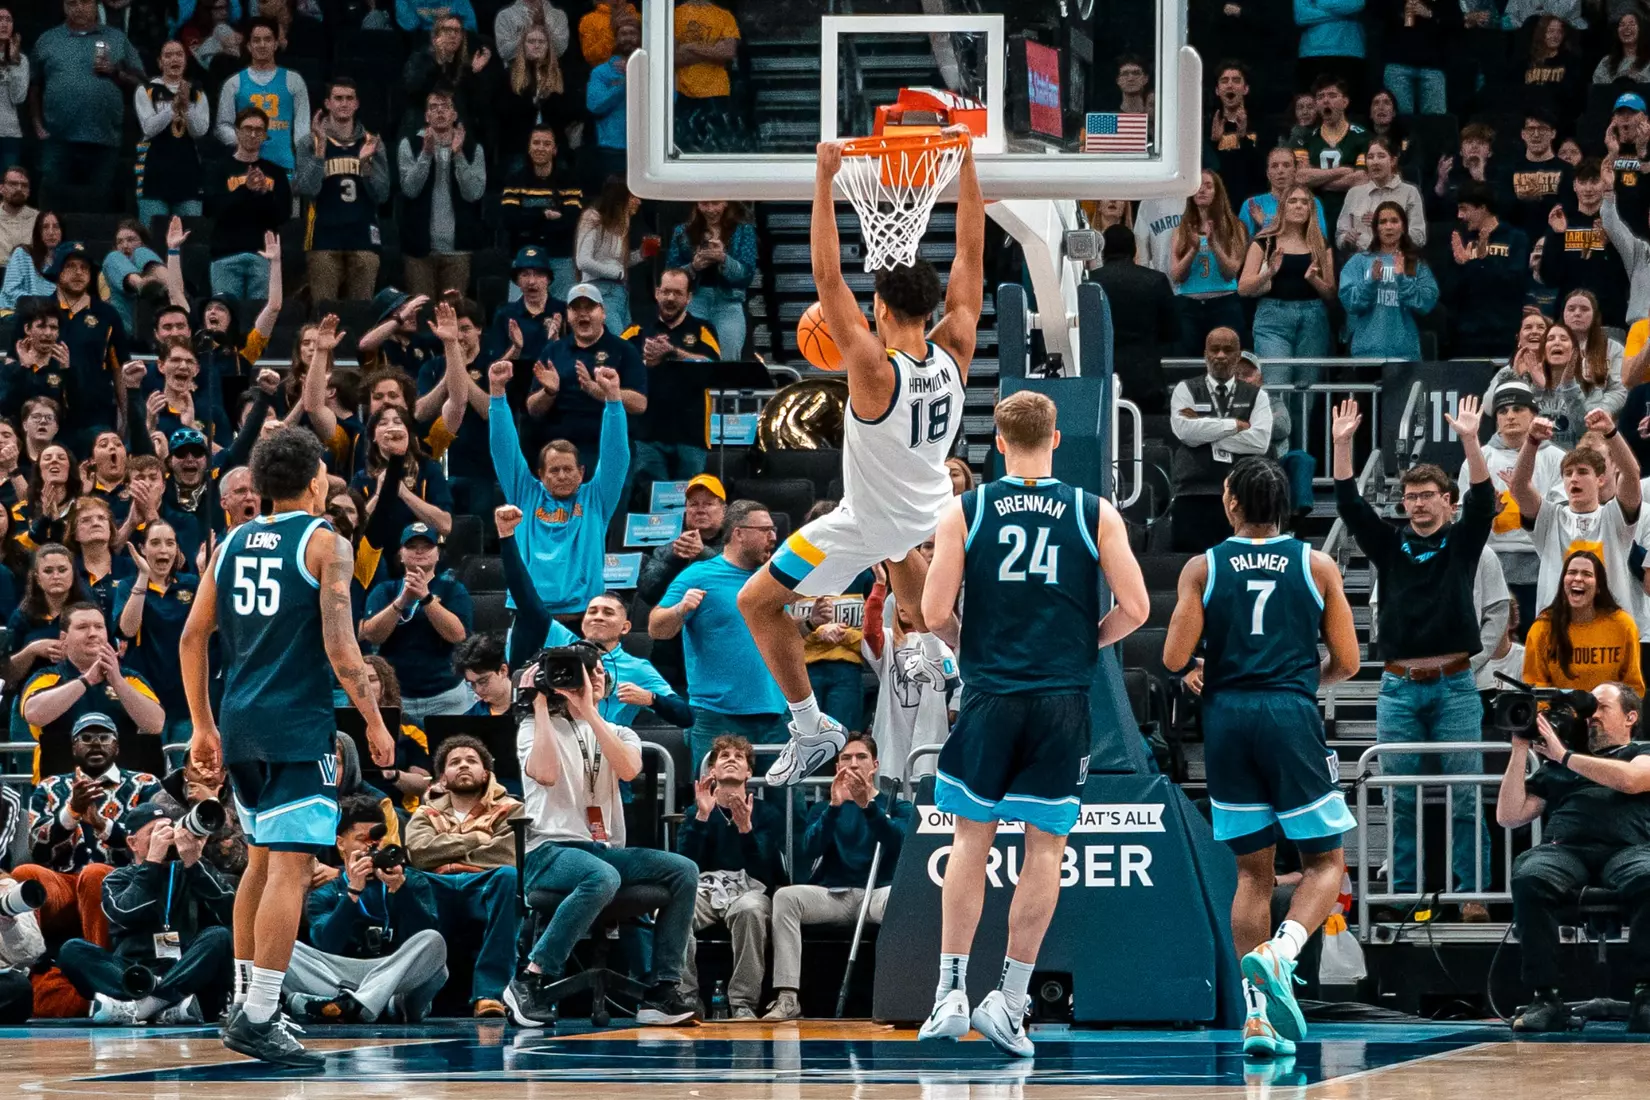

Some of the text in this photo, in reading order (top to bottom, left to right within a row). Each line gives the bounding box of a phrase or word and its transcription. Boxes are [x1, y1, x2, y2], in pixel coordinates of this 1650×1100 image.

[340, 179, 357, 202] 3
[909, 392, 953, 448] 18
[993, 494, 1067, 520] BRENNAN
[245, 532, 282, 550] LEWIS
[997, 524, 1061, 584] 24
[1229, 553, 1289, 573] PALMER
[232, 556, 283, 616] 55
[1246, 580, 1277, 635] 7
[1125, 811, 1156, 826] ALL
